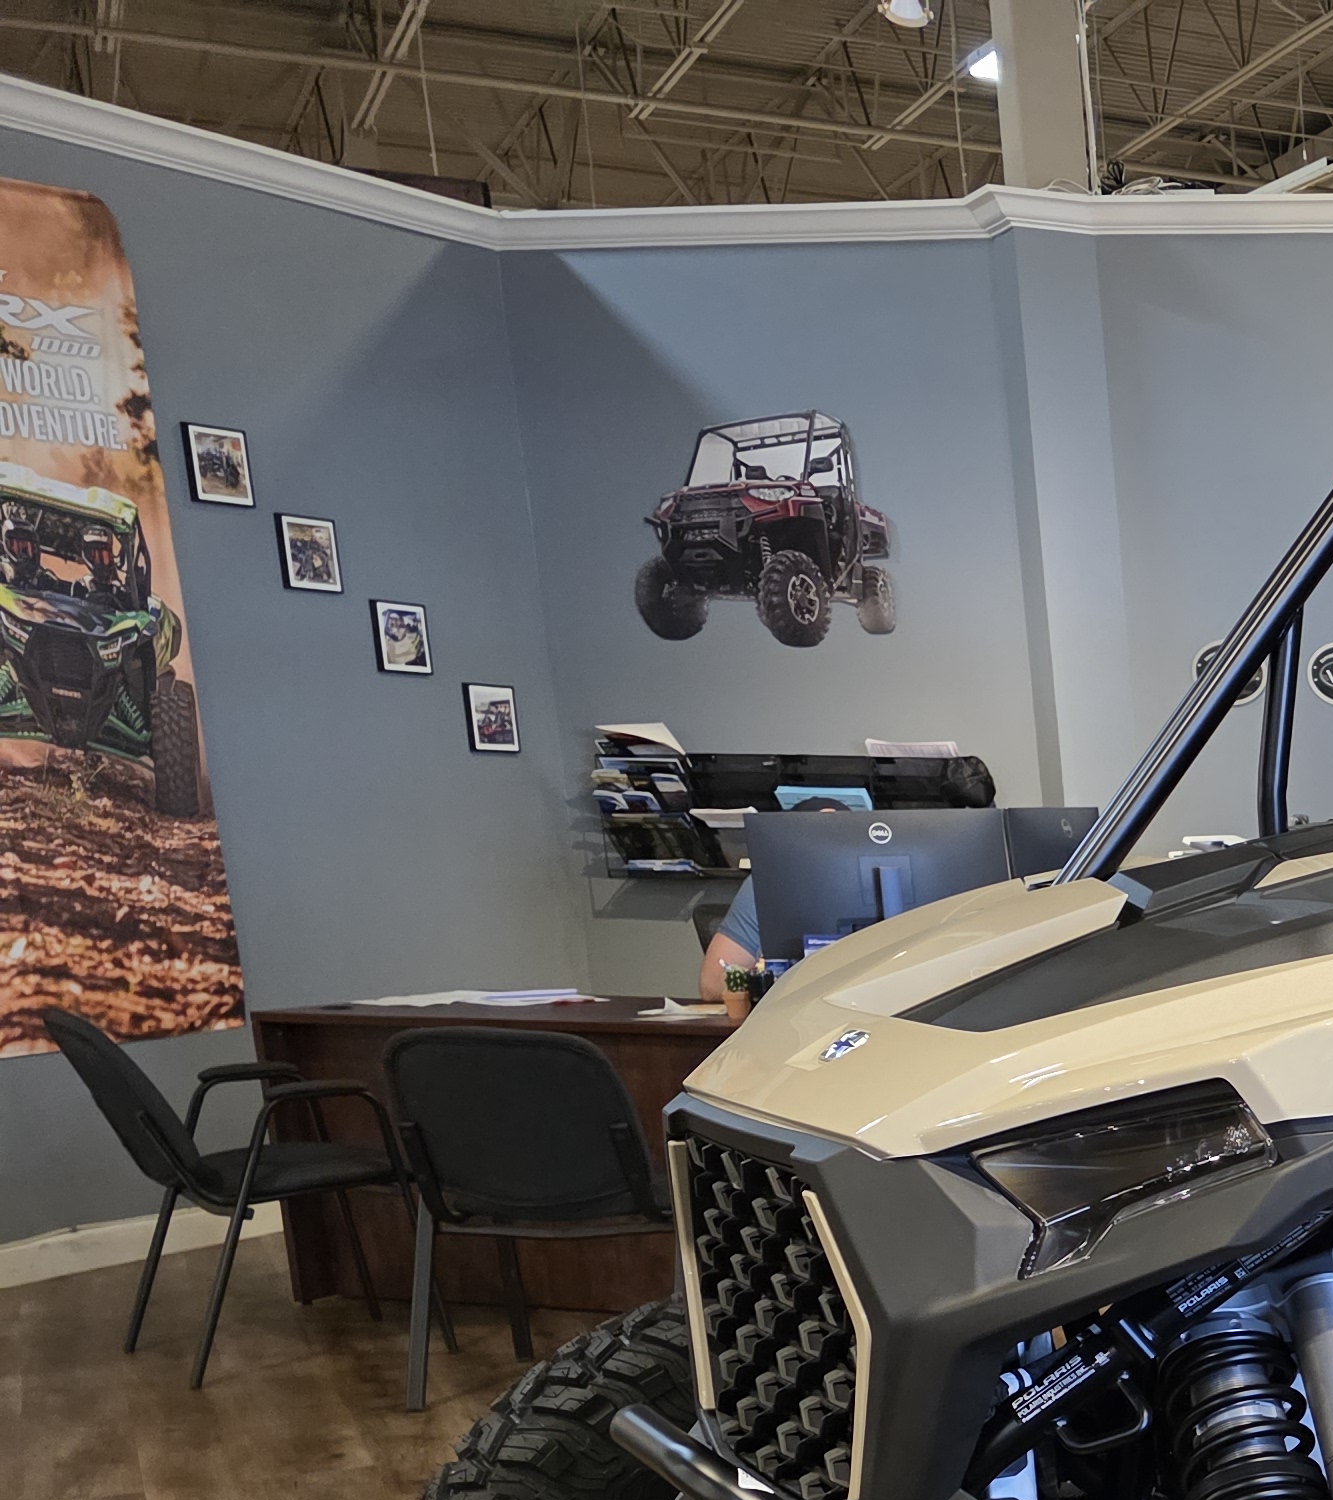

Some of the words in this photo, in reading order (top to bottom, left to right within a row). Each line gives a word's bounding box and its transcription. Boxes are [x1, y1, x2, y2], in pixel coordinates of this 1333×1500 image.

[0, 294, 97, 339] RX
[31, 336, 101, 358] 1000
[1, 358, 100, 404] WORLD.
[0, 402, 129, 451] DVENTURE.
[1178, 1276, 1229, 1313] POLARIS
[1011, 1354, 1082, 1410] POLARIS
